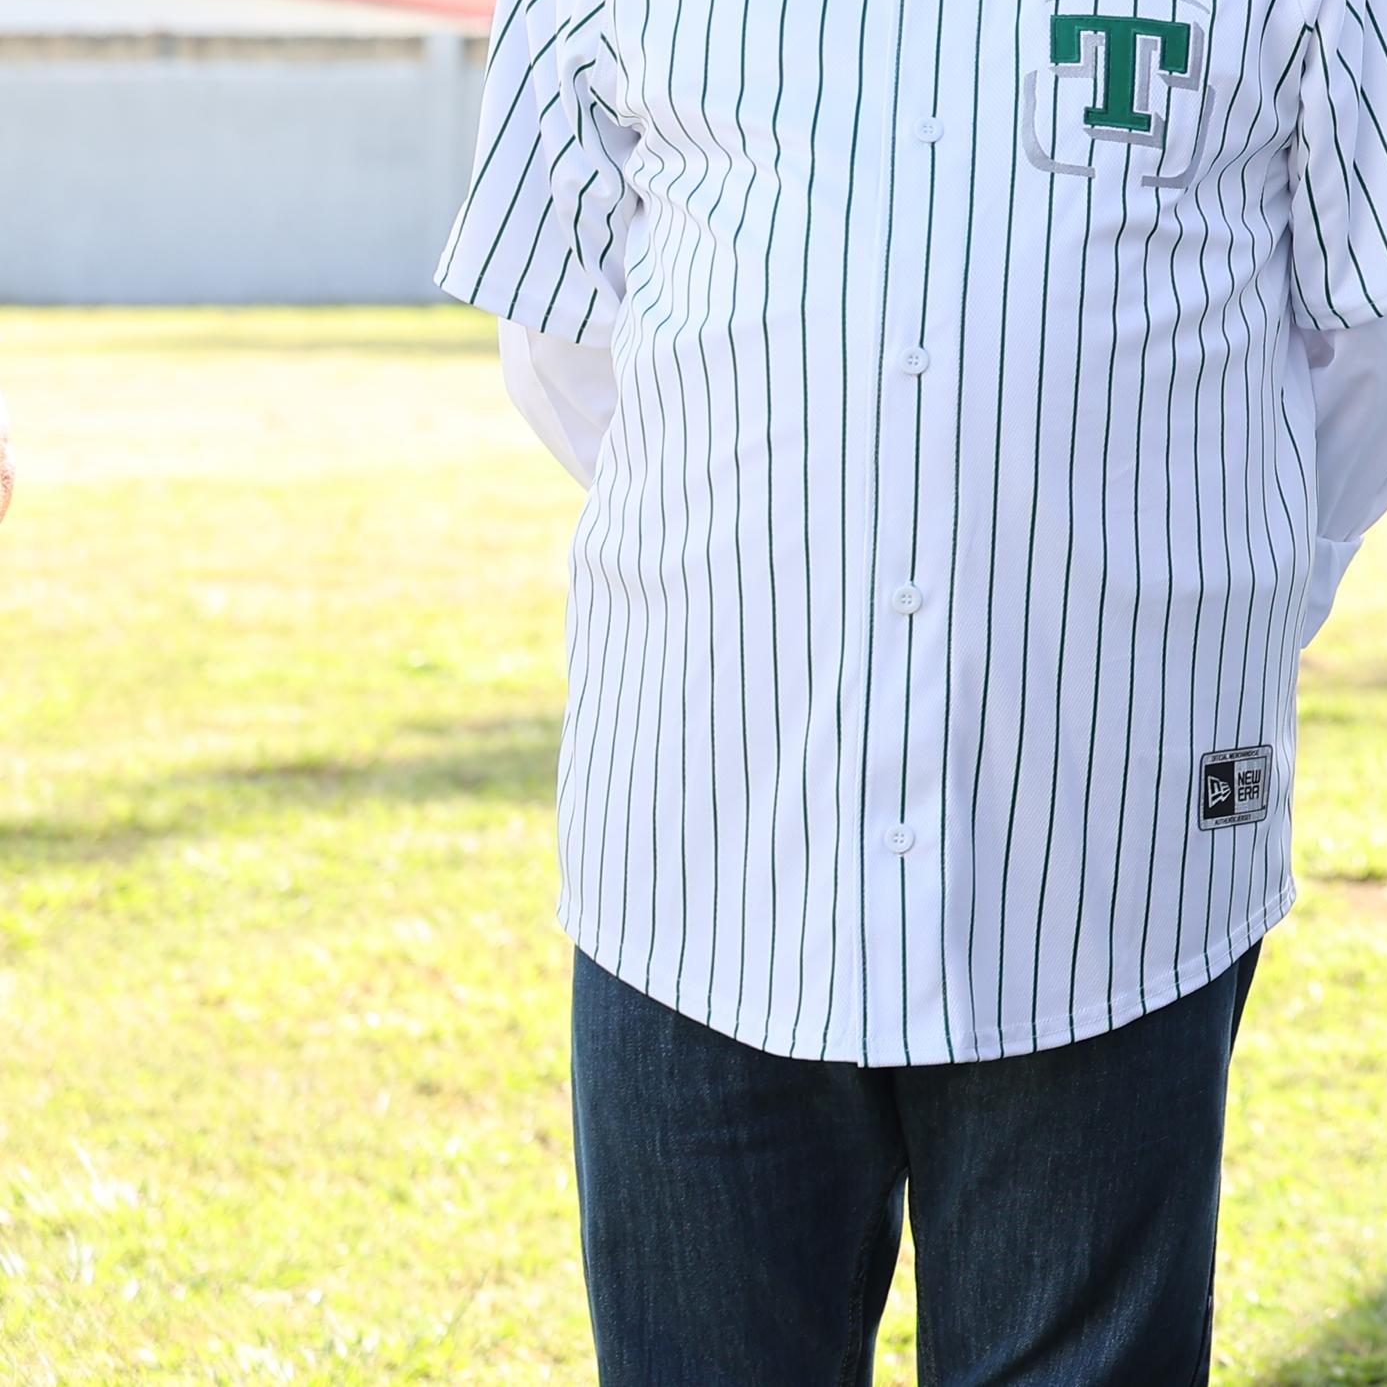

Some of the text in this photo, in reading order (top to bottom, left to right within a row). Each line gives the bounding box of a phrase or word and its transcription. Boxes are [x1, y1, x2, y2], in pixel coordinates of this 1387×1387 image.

[1049, 13, 1205, 150] T
[1237, 769, 1262, 787] NEW
[1237, 785, 1260, 802] ERA
